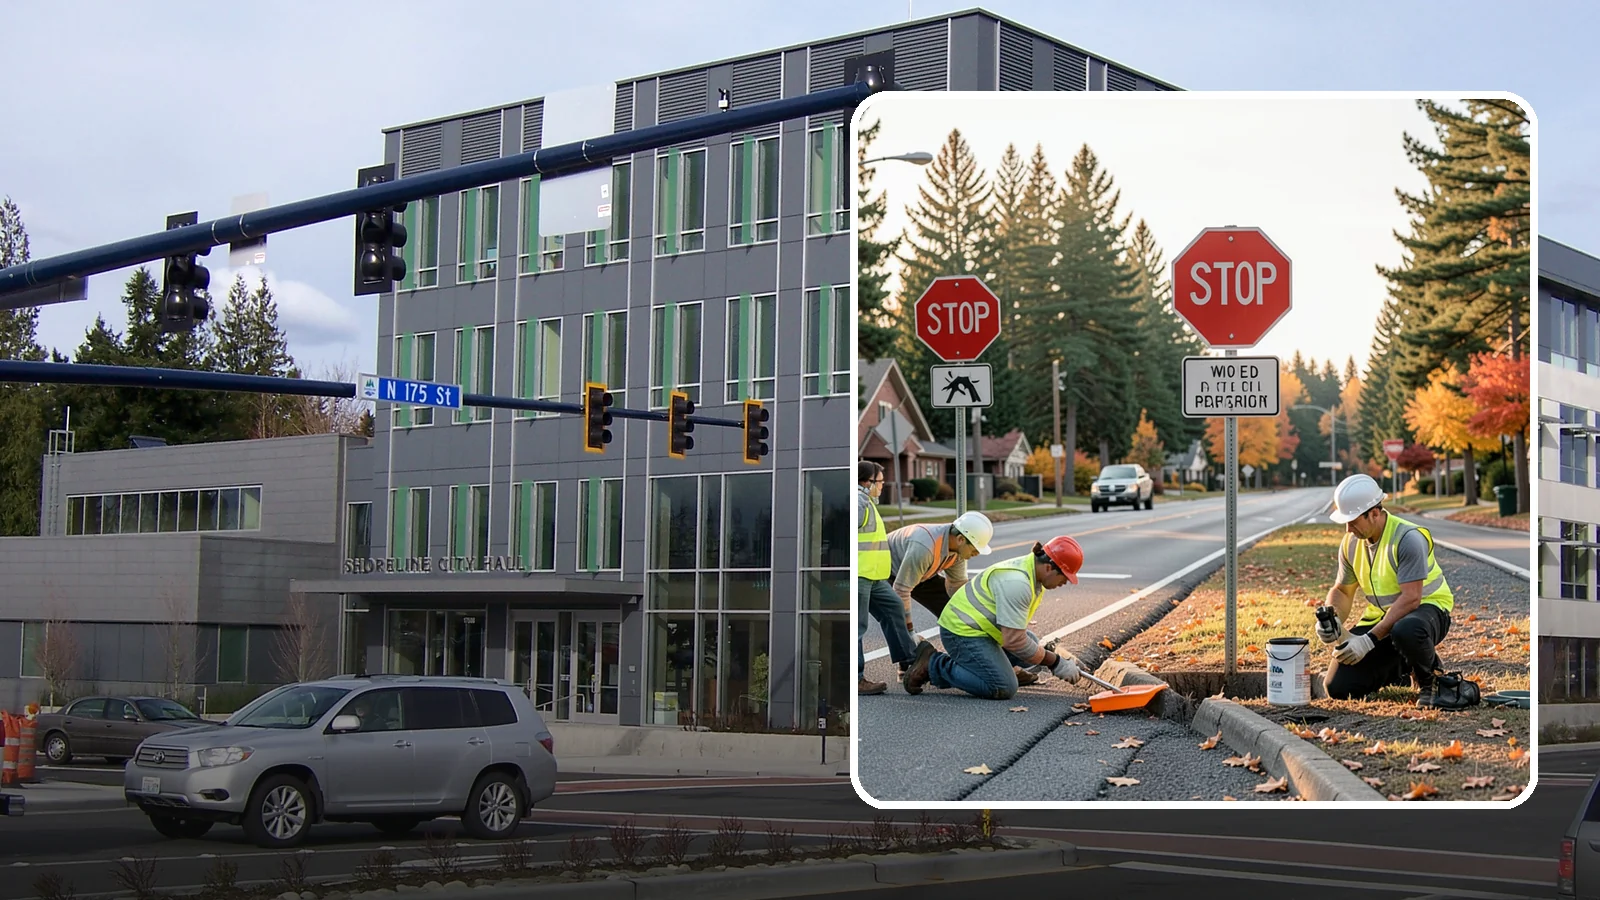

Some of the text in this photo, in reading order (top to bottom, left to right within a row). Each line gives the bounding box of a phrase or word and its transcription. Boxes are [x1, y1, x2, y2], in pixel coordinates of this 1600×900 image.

[1189, 260, 1278, 306] STOP
[926, 301, 991, 336] STOP
[387, 380, 452, 406] N 175 St
[344, 555, 526, 574] SHORELINE CITY HALL
